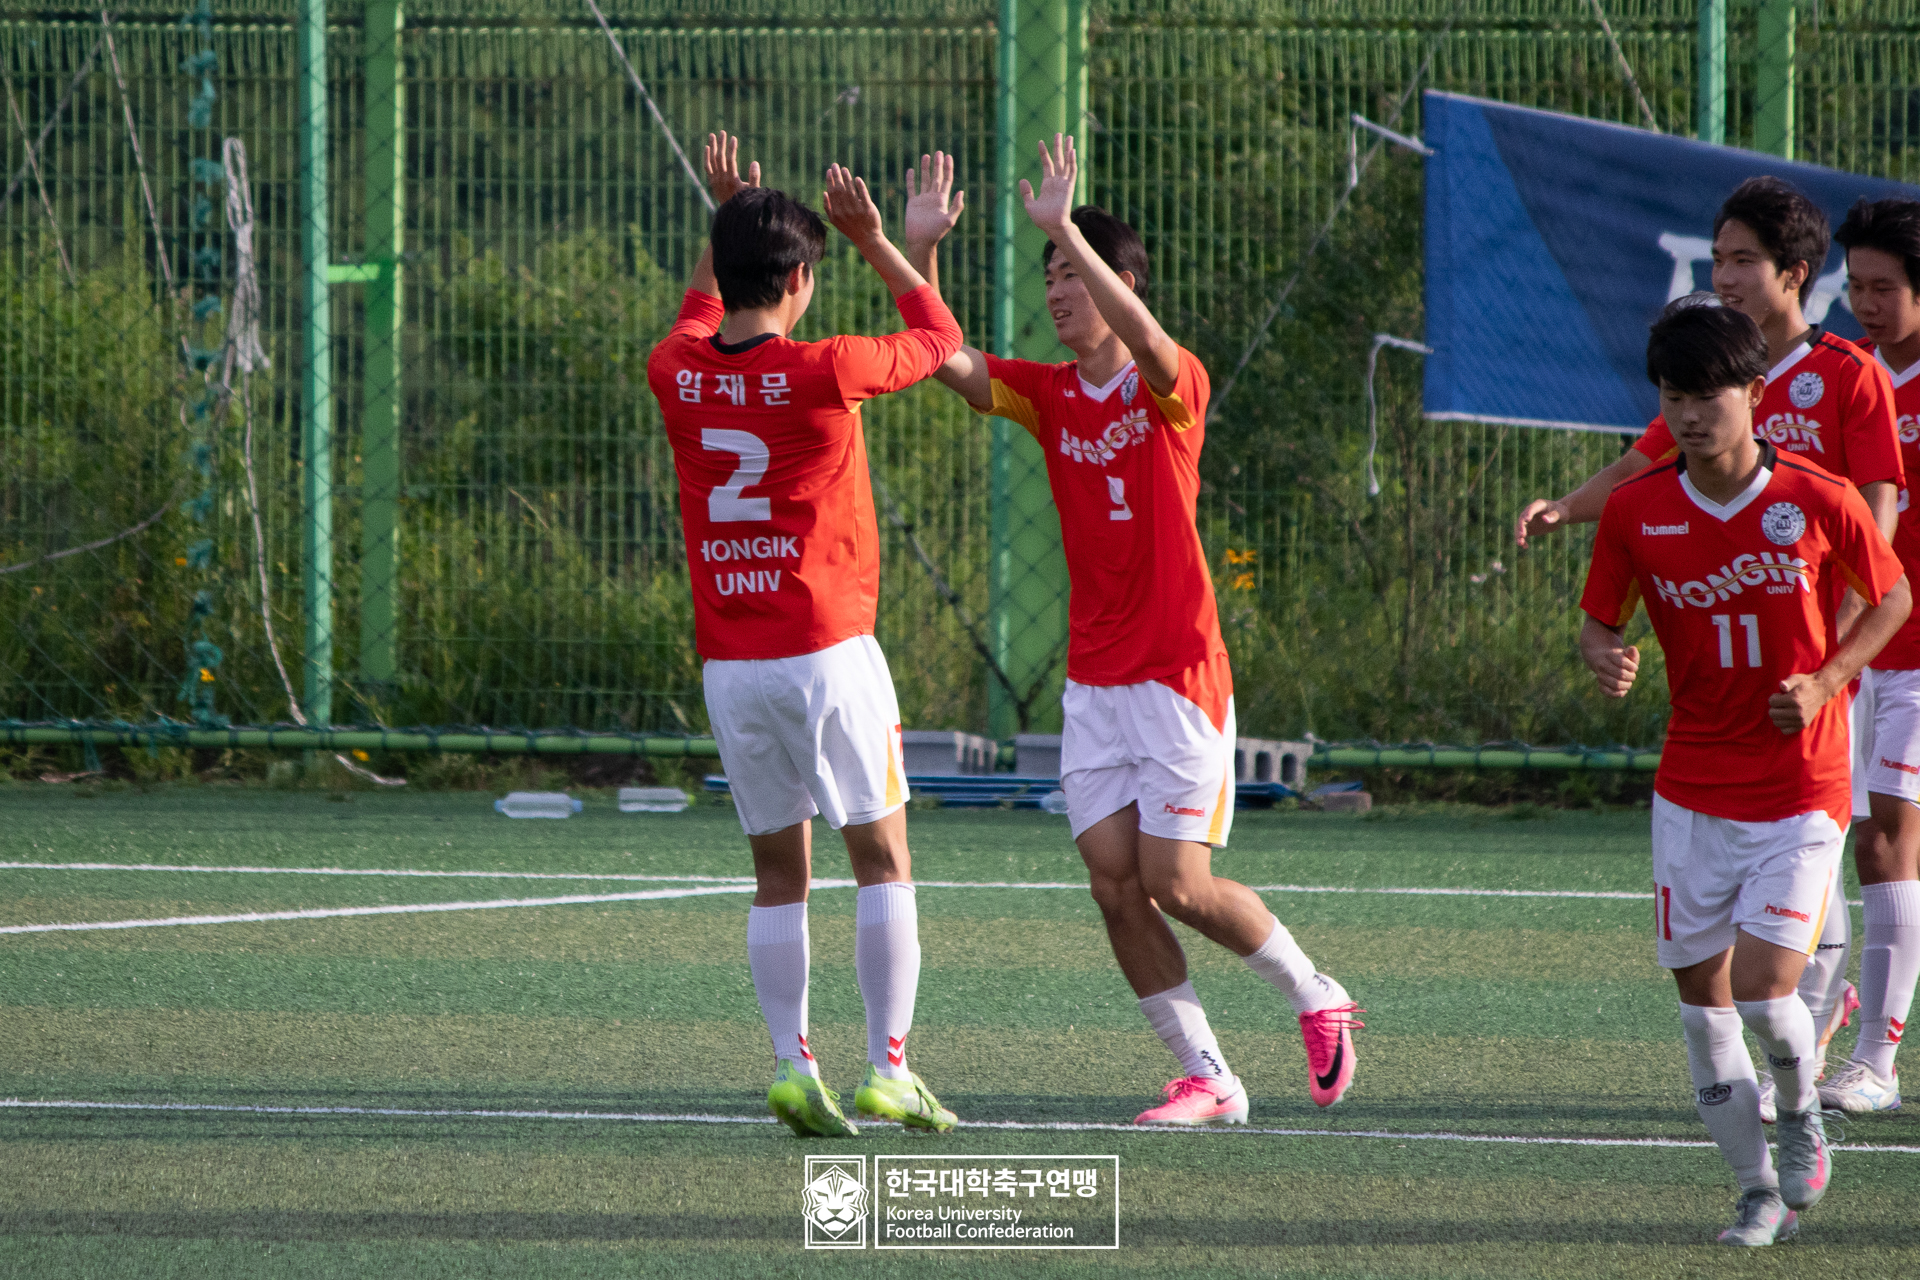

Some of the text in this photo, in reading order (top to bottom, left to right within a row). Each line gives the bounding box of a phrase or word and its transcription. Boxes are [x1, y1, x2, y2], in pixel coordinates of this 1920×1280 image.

[701, 427, 771, 522] 2
[1641, 520, 1690, 536] hummel
[715, 569, 782, 596] UNIV
[1651, 551, 1811, 609] HONGIK
[1766, 585, 1795, 595] UNIV
[1711, 613, 1763, 669] 11
[1764, 903, 1811, 924] hummel
